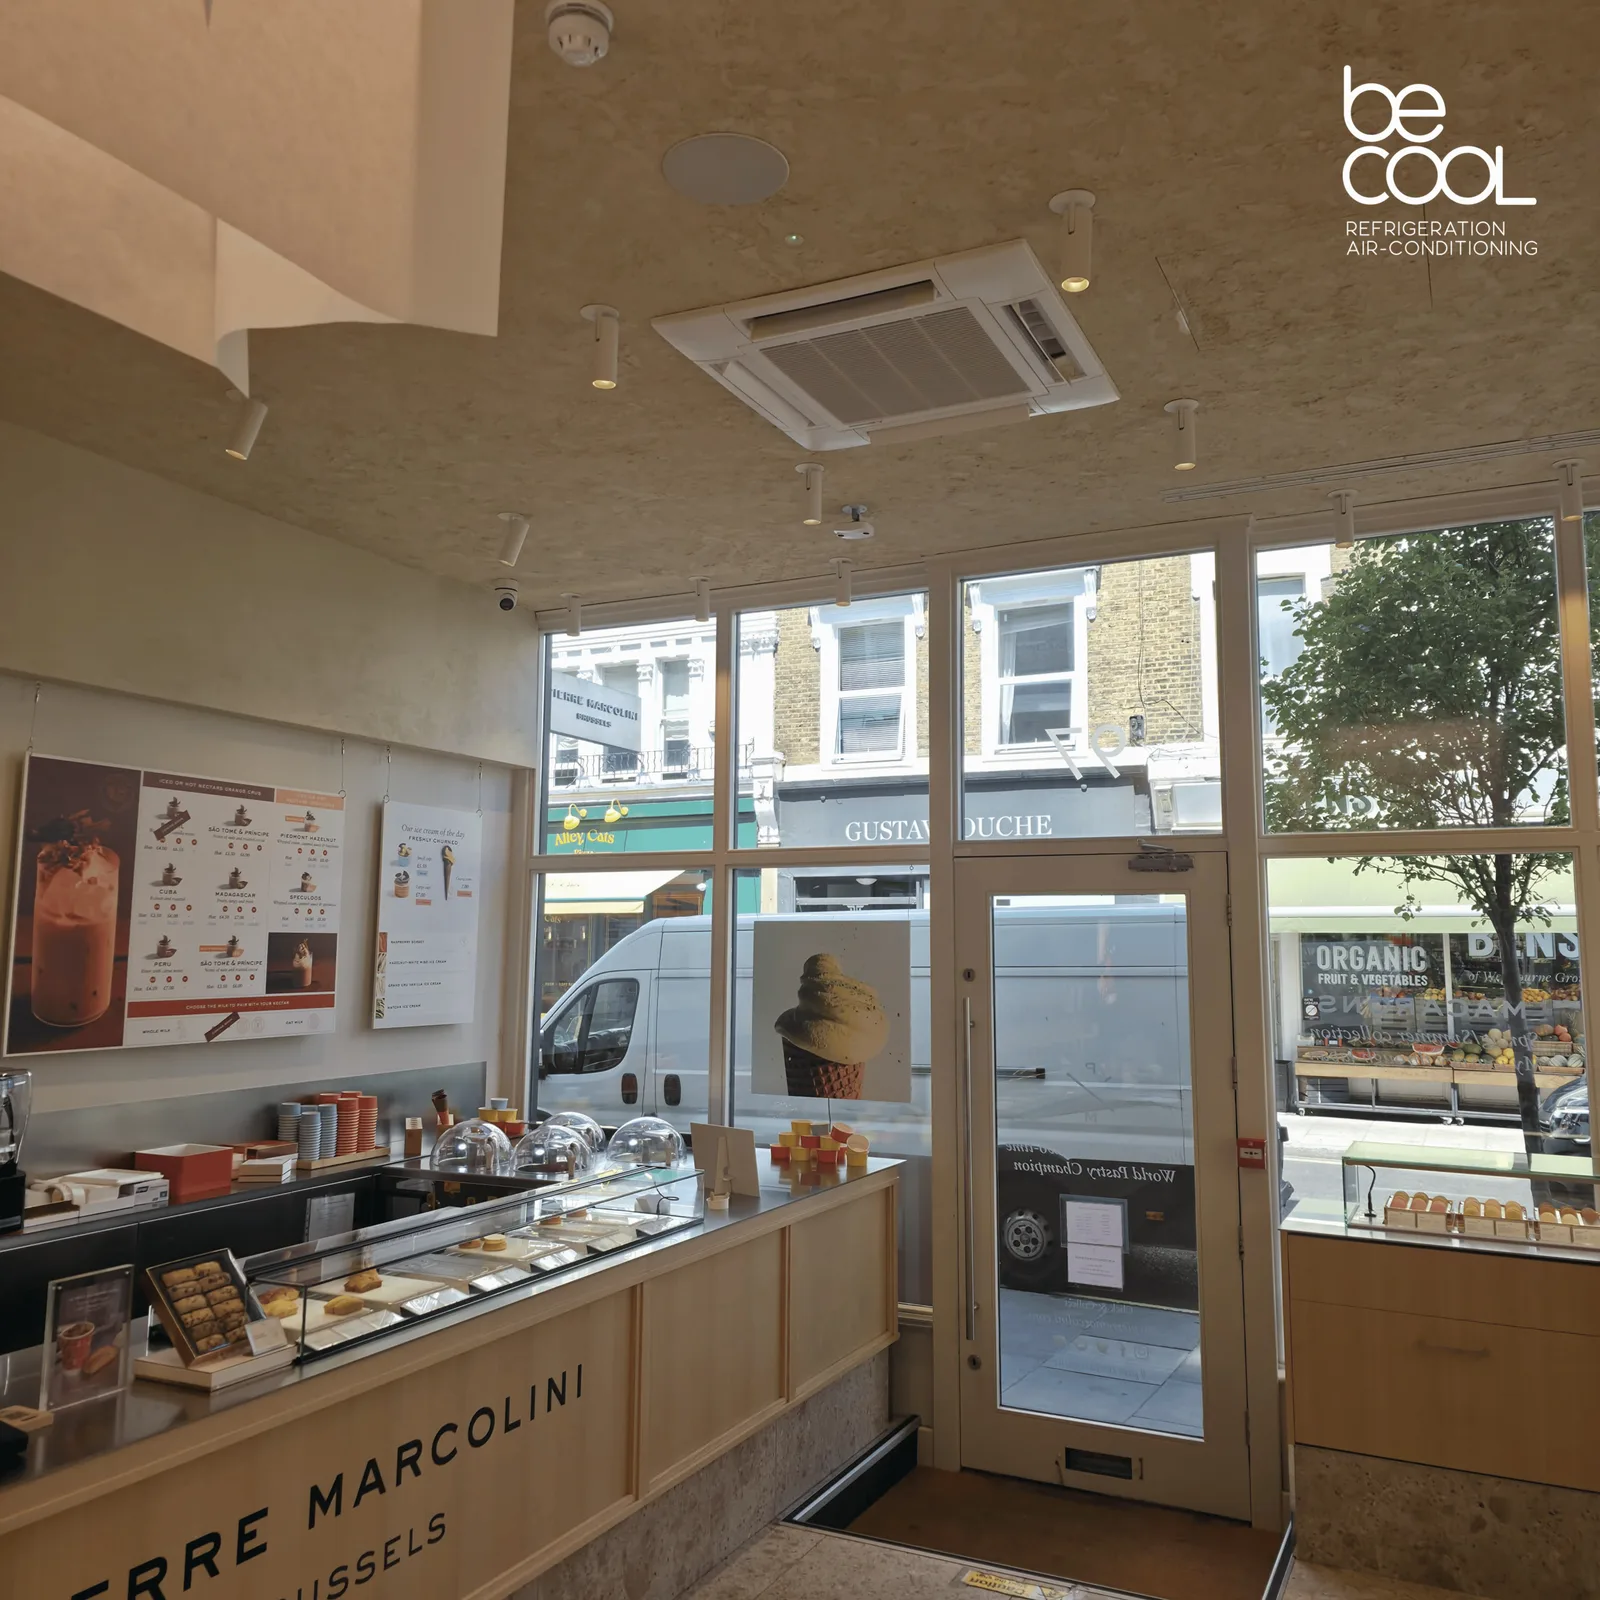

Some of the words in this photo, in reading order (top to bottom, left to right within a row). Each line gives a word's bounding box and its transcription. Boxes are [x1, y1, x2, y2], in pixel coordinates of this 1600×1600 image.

[551, 688, 584, 705] IERRE
[586, 698, 638, 721] MARCOLINI
[576, 712, 612, 728] BRUSSELS
[401, 823, 413, 832] Our
[446, 828, 455, 836] the
[555, 832, 584, 847] Alley
[587, 829, 615, 844] Cats
[309, 835, 337, 843] HAZELNUT
[1467, 933, 1580, 960] BNS
[1316, 945, 1428, 972] ORGANIC
[1318, 973, 1348, 985] FRUIT
[1350, 974, 1359, 985] &
[1361, 974, 1429, 987] VEGETABLES
[1468, 971, 1480, 984] of
[1555, 972, 1580, 983] Gro
[308, 1363, 585, 1530] MARCOLINI
